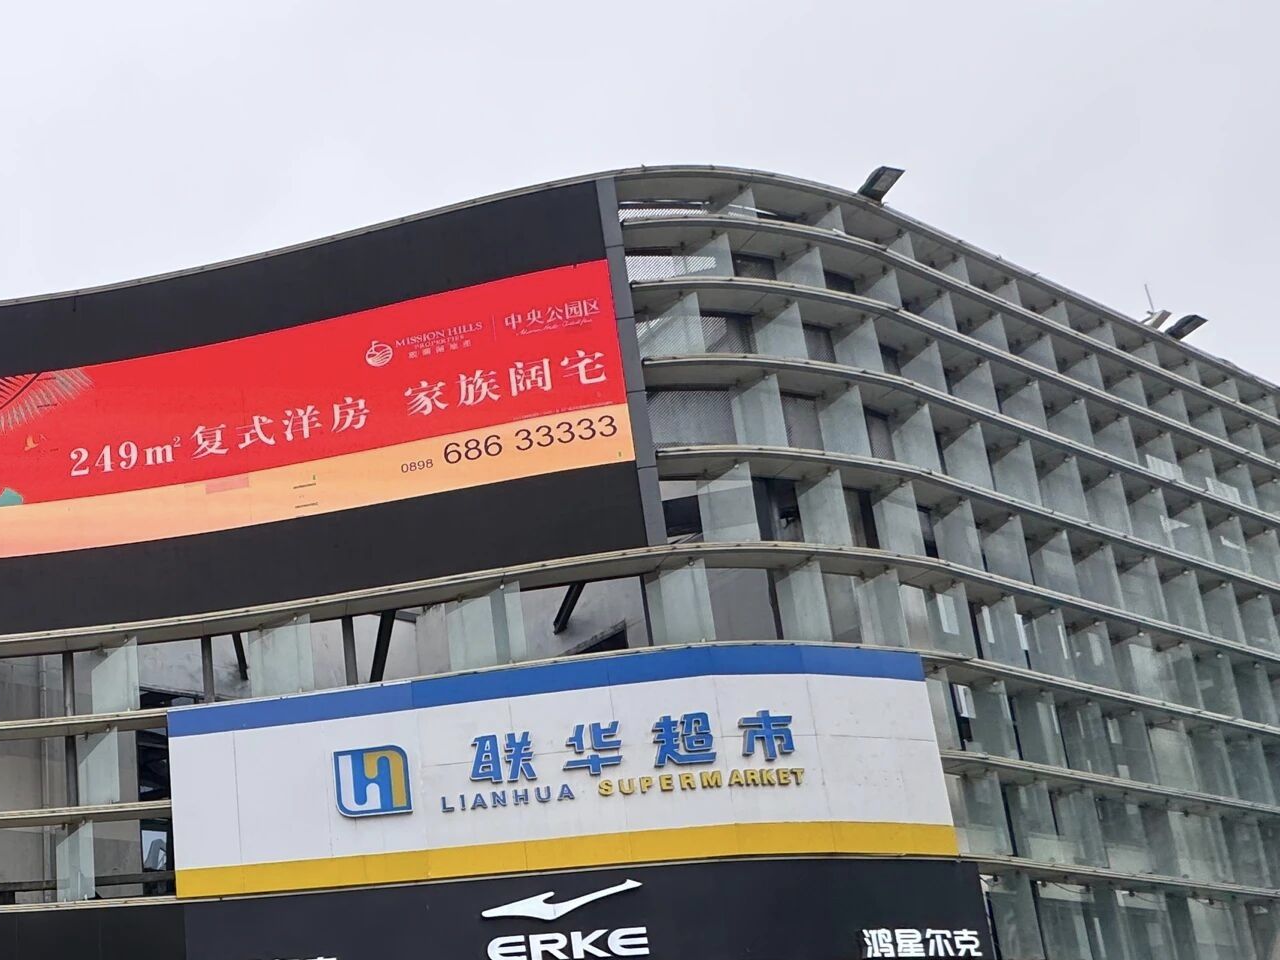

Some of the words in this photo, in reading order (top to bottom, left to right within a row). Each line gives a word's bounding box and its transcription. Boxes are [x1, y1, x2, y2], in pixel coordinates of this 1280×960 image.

[395, 330, 445, 348] MISSION
[448, 321, 483, 338] HILLS
[504, 298, 601, 331] 中央公园区
[190, 397, 370, 460] 复式洋房
[404, 350, 607, 416] 家族阔宅
[401, 458, 434, 474] 0898
[443, 434, 503, 465] 686
[515, 415, 618, 451] 33333
[470, 710, 796, 783] 联华超市
[441, 783, 575, 813] LIANHUA
[598, 767, 805, 797] SUPERMARKET
[862, 928, 983, 958] 鸿星尔克
